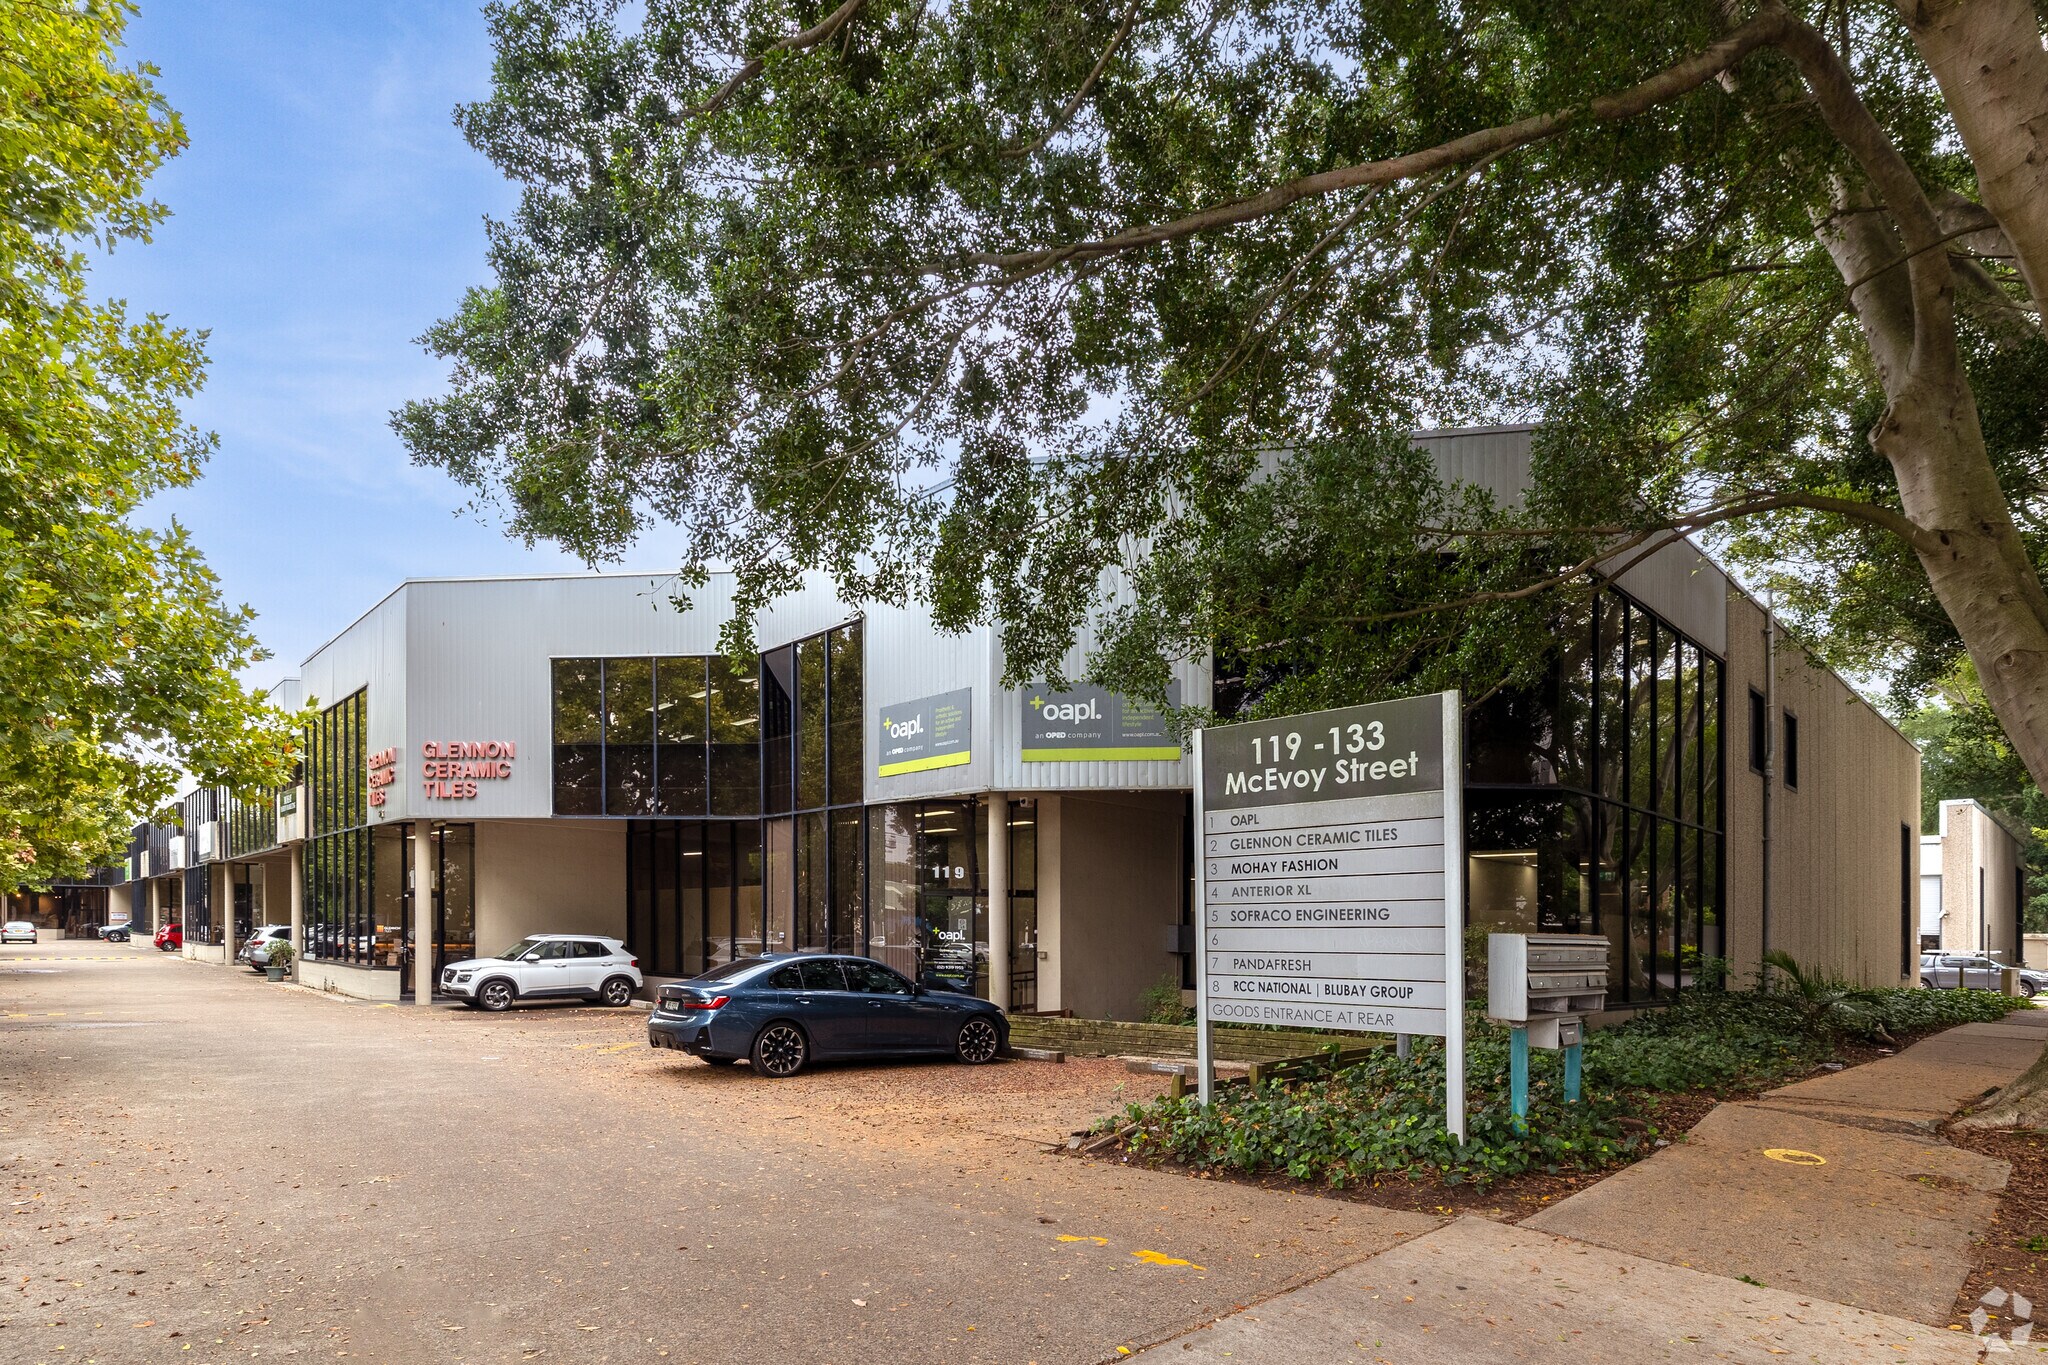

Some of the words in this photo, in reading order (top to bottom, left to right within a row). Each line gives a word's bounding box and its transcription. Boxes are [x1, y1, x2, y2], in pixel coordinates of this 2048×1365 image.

[1045, 731, 1066, 739] OPED
[422, 740, 515, 759] GLENNON
[1251, 732, 1302, 764] 119
[422, 760, 512, 779] CERAMIC
[1225, 767, 1327, 795] McEvoy
[1335, 751, 1419, 785] Street
[423, 780, 478, 799] TILES
[1230, 814, 1260, 827] OAPL
[1210, 839, 1218, 852] 2
[1230, 835, 1292, 851] GLENNON
[1296, 831, 1361, 847] CERAMIC
[1364, 828, 1398, 842] TILES
[1210, 863, 1218, 875] 3
[1231, 861, 1278, 875] MOHAY
[1282, 858, 1339, 872] FASHION
[1211, 887, 1219, 899] 4
[1231, 885, 1294, 898] ANTERIOR
[1297, 884, 1312, 896] XL
[1211, 911, 1219, 922] 5
[1230, 909, 1292, 922] SOFRACO
[1295, 907, 1391, 922] ENGINEERING
[1211, 934, 1219, 946] 6
[1211, 957, 1218, 969] 7
[1233, 958, 1312, 972] PANDAFRESH
[1212, 980, 1220, 992] 8
[1233, 980, 1255, 992] RCC
[1258, 981, 1312, 995] NATIONAL
[1324, 983, 1367, 998] BLUBAY
[1370, 985, 1414, 999] GROUP
[1212, 1003, 1260, 1019] GOODS
[1264, 1008, 1333, 1023] ENTRANCE
[1336, 1010, 1354, 1024] AT
[1357, 1012, 1395, 1027] REAR
